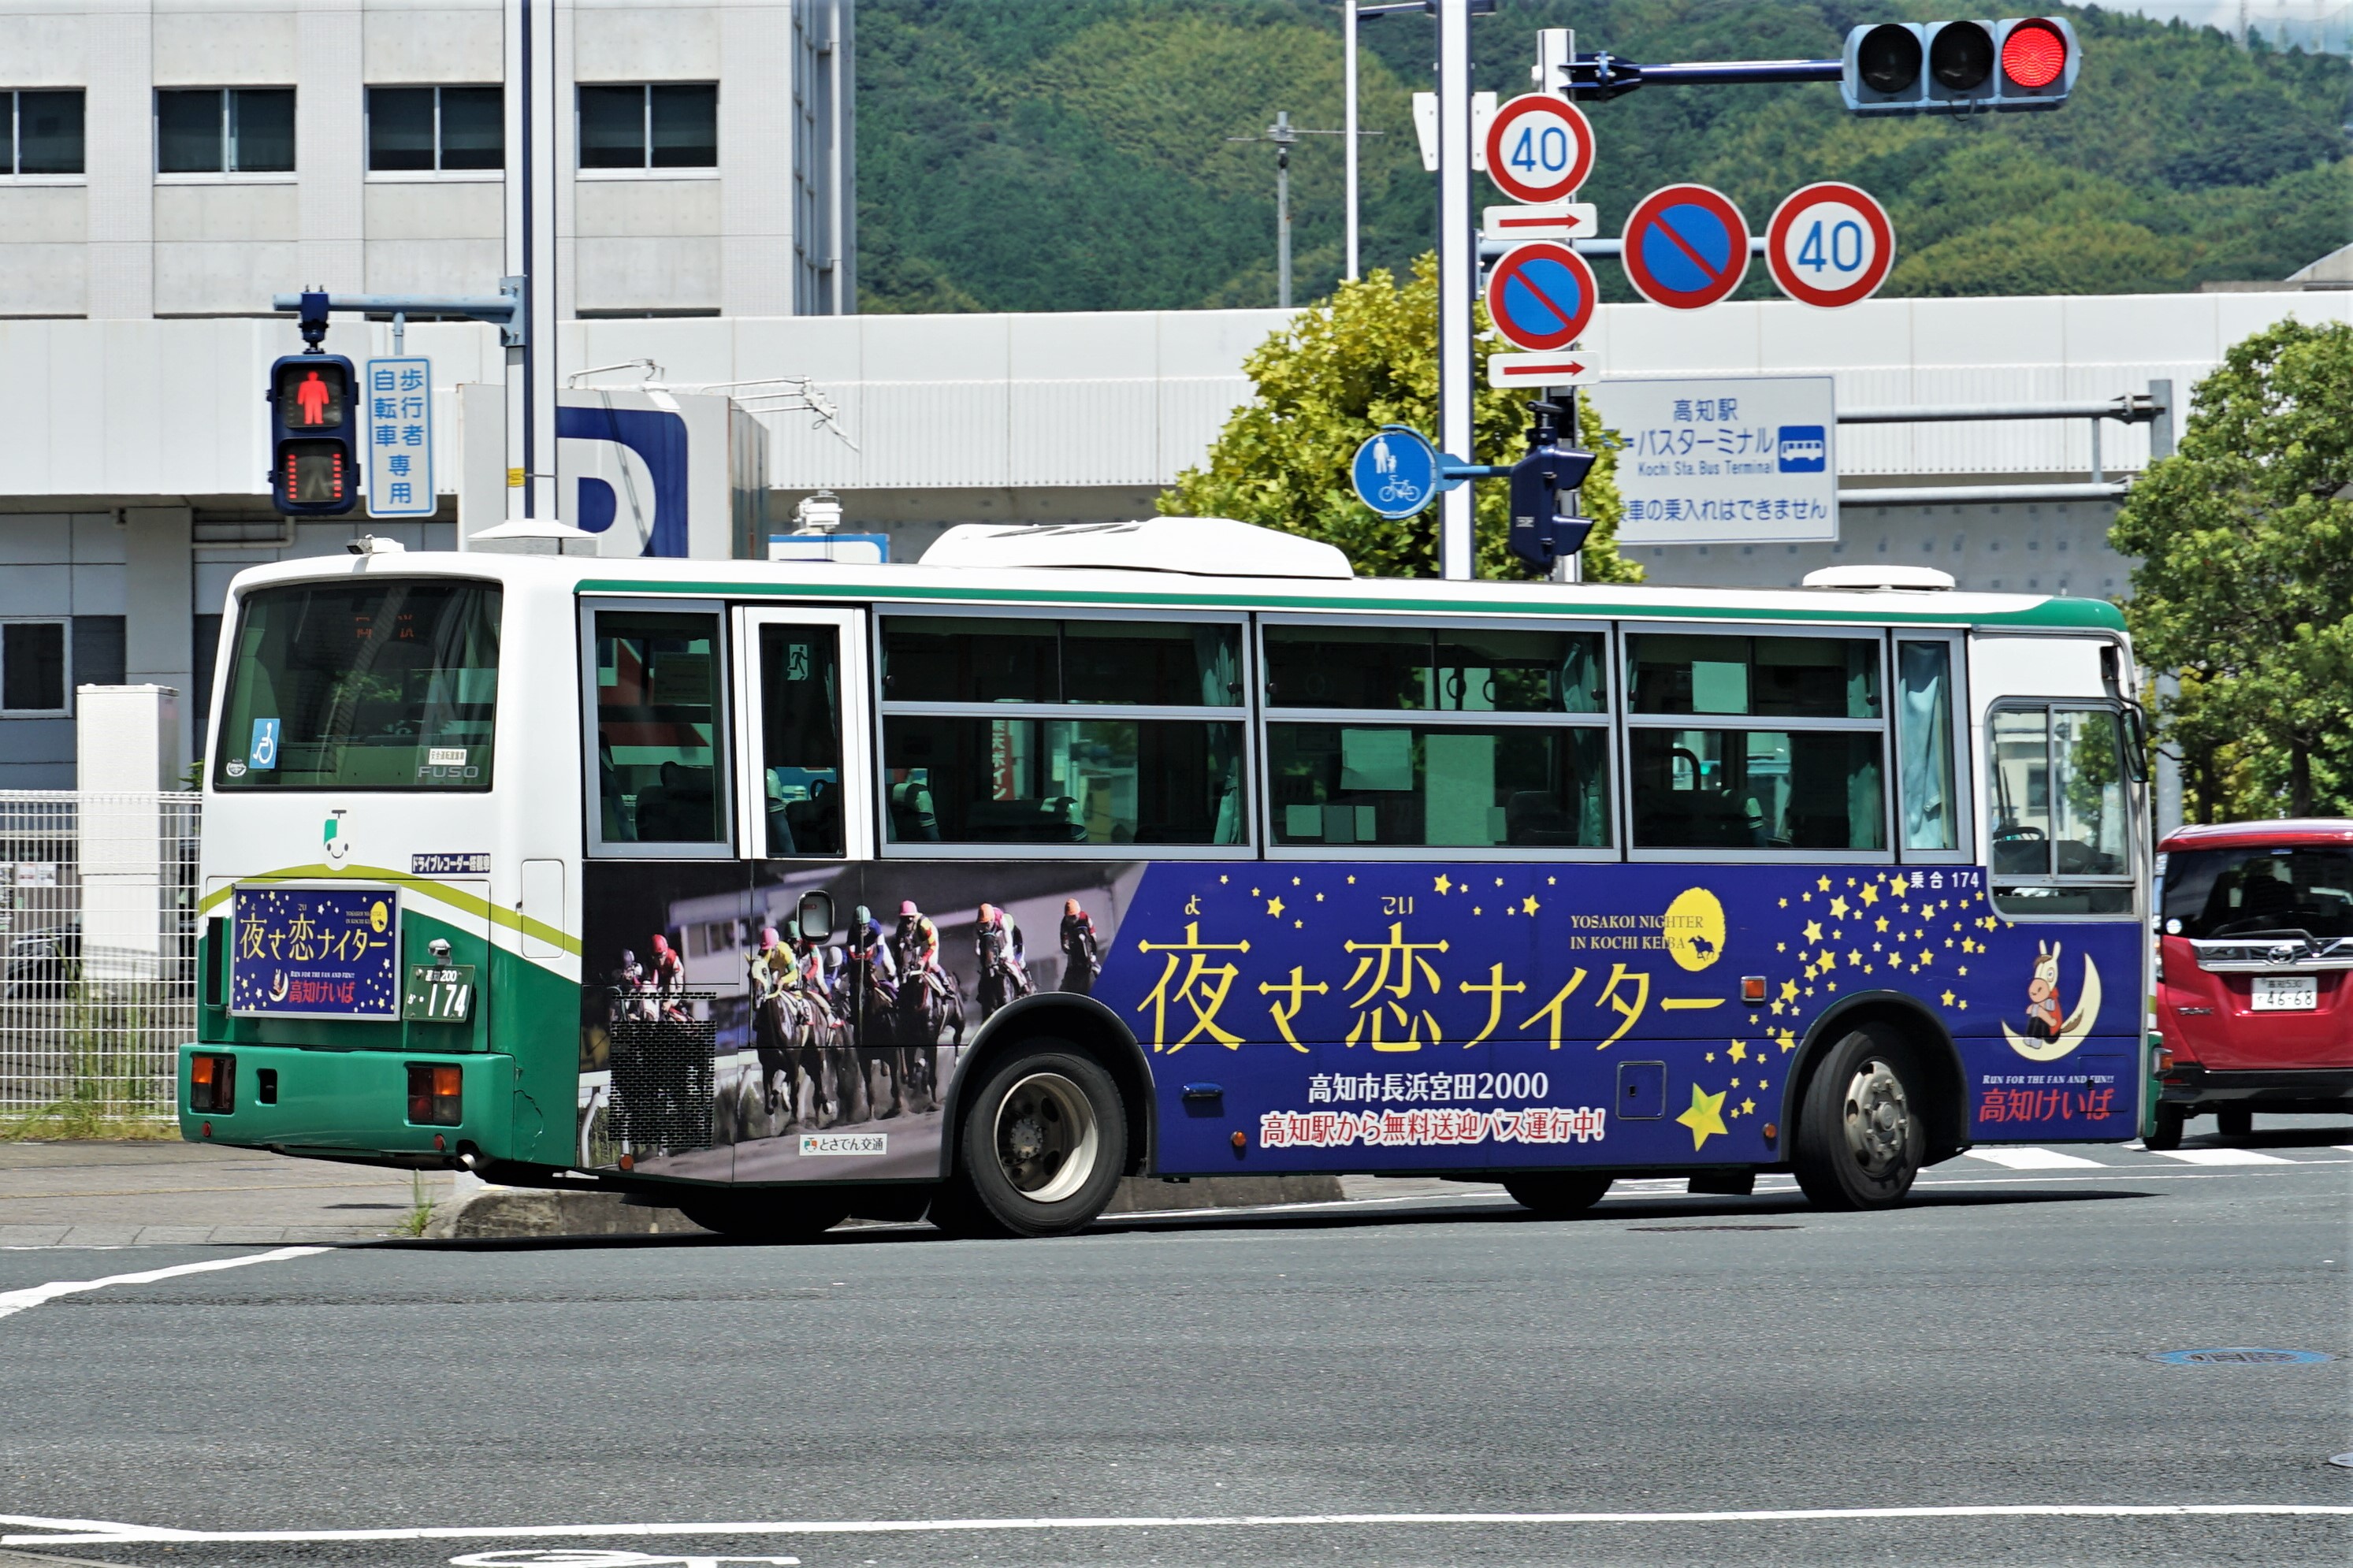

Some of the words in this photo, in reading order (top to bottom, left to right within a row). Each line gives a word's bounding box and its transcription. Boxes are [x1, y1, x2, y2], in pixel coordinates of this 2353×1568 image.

[1511, 126, 1568, 173] 40
[1797, 220, 1863, 273] 40
[374, 369, 398, 447] 自転車
[400, 369, 425, 447] 歩行者
[1673, 398, 1738, 422] 高知駅
[1637, 428, 1774, 457] バスターミナル
[388, 455, 412, 505] 専用
[1637, 461, 1671, 477] Kochi
[1699, 460, 1720, 475] Bus
[1725, 459, 1772, 474] Terminal
[417, 766, 479, 778] FUSO
[1910, 871, 1944, 889] 乗合
[1952, 871, 1979, 888] 174
[1184, 894, 1202, 916] よ
[1381, 895, 1414, 916] こい
[1571, 915, 1636, 928] YOSAKOI
[1639, 915, 1704, 928] NIGHTER
[1570, 936, 1586, 949] IN
[1590, 936, 1638, 949] KOCHI
[1642, 935, 1686, 949] KEIBA
[288, 979, 356, 1004] 高知けいば
[1137, 920, 1726, 1055] 夜さ恋ナイター
[2266, 989, 2314, 1007] 46-68
[1308, 1072, 1549, 1103] 高知市長浜宮田2000
[1982, 1075, 2004, 1084] RUN
[2005, 1075, 2025, 1084] FOR
[2027, 1075, 2046, 1084] THE
[2046, 1075, 2066, 1084] FAN
[2066, 1075, 2087, 1084] AND
[1979, 1087, 2115, 1123] 高知けいば
[820, 1137, 883, 1151] とさでん交通
